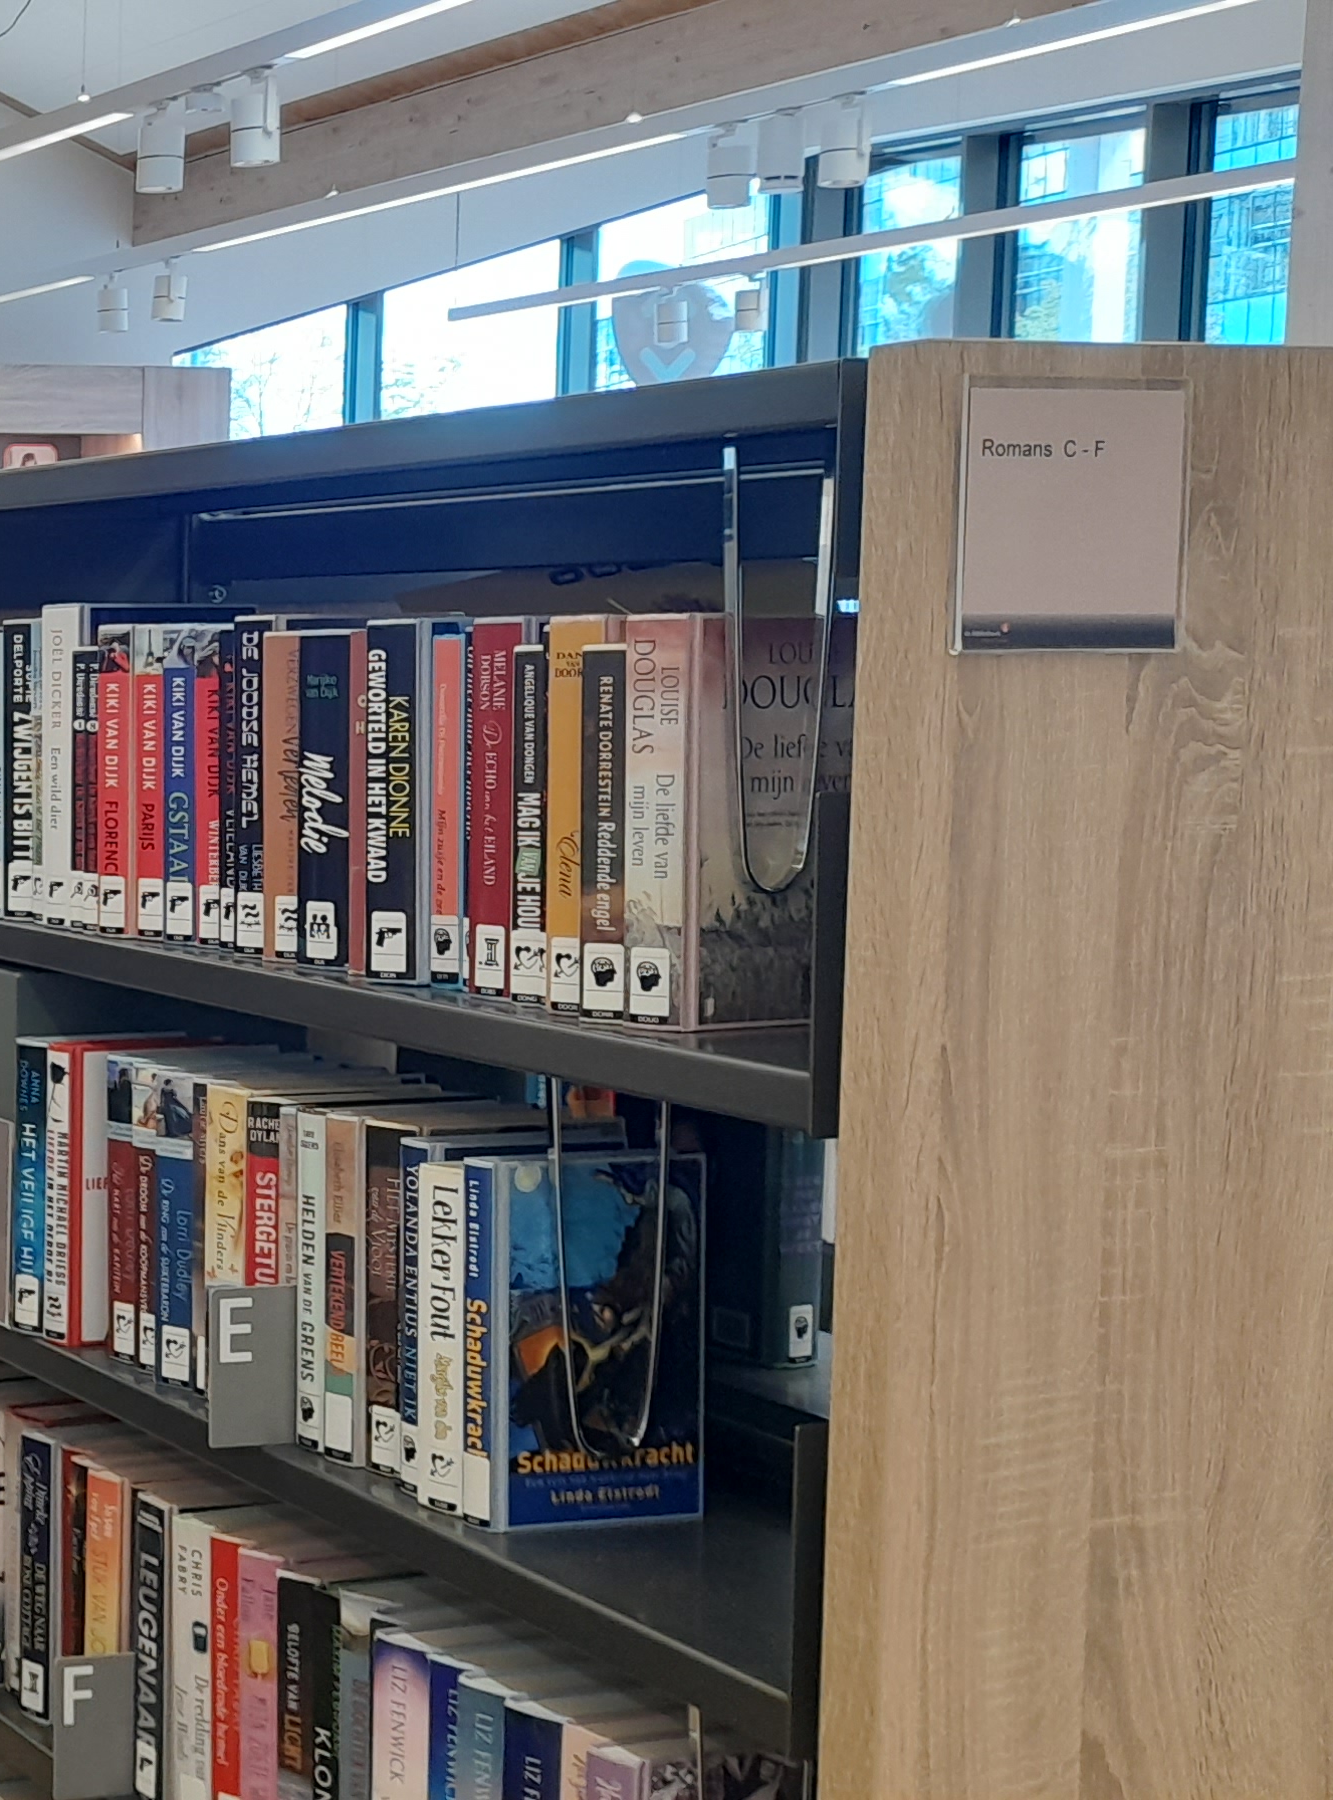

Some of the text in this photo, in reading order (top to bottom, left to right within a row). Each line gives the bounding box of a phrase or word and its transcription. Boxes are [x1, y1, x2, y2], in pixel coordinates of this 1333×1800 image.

[981, 438, 1053, 458] Romans
[1063, 440, 1077, 458] C
[1094, 440, 1105, 458] F
[493, 649, 507, 711] MELANIE
[524, 664, 535, 719] ANGELIQUE
[660, 666, 680, 727] LOUISE
[13, 634, 33, 814] DELPORTE ZWIJGEN IS
[50, 628, 63, 830] JOËL DICKER Een wild dier
[241, 631, 259, 829] DE JOODSE HEMEL
[524, 720, 535, 741] VAN
[103, 683, 119, 876] KIKI VAN DIJK FLORENC
[140, 683, 156, 851] KIKI VAN DIJK PARIJS
[168, 677, 189, 882] KIKI VAN DIJK GSTAA
[367, 649, 387, 883] GEWORTELD IN HET KWAAD
[388, 696, 410, 838] KAREN DIONNE
[484, 751, 497, 790] ECHO
[524, 742, 535, 784] DONGEN
[632, 638, 675, 880] DOUGLAS De liefde van
[750, 769, 794, 800] mijn
[299, 751, 350, 854] Melodie
[518, 792, 541, 826] MAG
[595, 675, 617, 932] RENATE DORRESTEIN Reddende engel
[631, 784, 646, 868] mijn leven
[483, 836, 497, 886] EILAND
[518, 831, 541, 847] IK
[517, 874, 541, 894] JE
[517, 896, 541, 931] HOU
[30, 1071, 41, 1104] ANNA
[21, 1123, 37, 1160] HET
[217, 1101, 239, 1154] Dans
[56, 1132, 69, 1178] MARTIN
[217, 1156, 227, 1184] van
[55, 1183, 68, 1237] MICHAEL
[161, 1199, 170, 1224] RING
[217, 1188, 228, 1207] de
[469, 1180, 481, 1214] Linda
[431, 1184, 460, 1278] Lekker
[172, 1248, 193, 1303] Dudley
[300, 1194, 316, 1383] HELDEN VAN DE GRENS
[330, 1250, 346, 1330] VERTEKEND
[403, 1164, 420, 1427] YOLANDA ENTIUS NIET IK
[219, 1297, 253, 1364] E
[550, 1487, 594, 1506] Linda
[177, 1545, 188, 1595] FABRY
[191, 1549, 203, 1598] CHRIS
[63, 1665, 93, 1726] F
[389, 1664, 408, 1785] LIZ FENWICK
[475, 1713, 494, 1745] LIZ
[523, 1756, 542, 1785] LIZ
